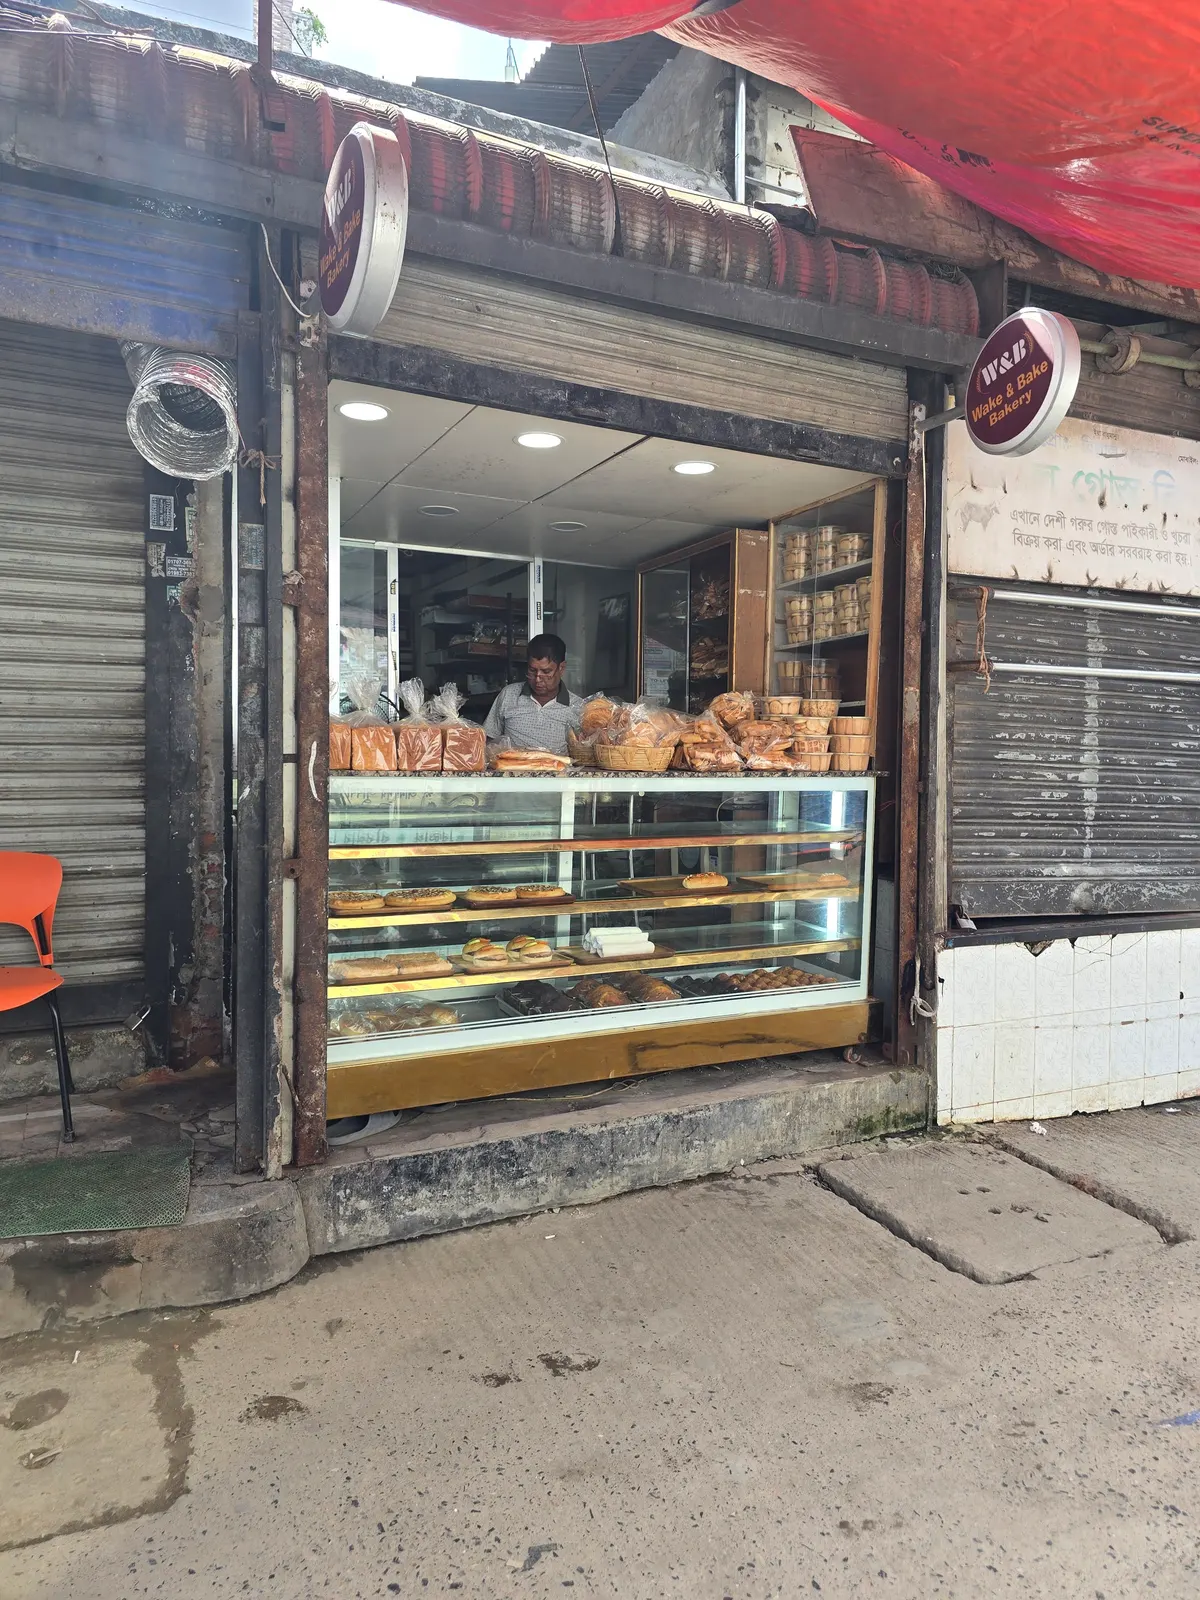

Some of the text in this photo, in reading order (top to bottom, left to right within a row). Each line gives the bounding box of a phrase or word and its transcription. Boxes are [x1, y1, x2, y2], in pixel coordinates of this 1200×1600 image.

[327, 167, 352, 227] W&B
[321, 245, 337, 277] Wake
[343, 209, 361, 245] Bake
[327, 248, 350, 288] Bakery
[981, 338, 1027, 387] W&B
[971, 360, 1049, 423] Wake & Bake
[989, 389, 1033, 427] Bakery
[1010, 509, 1041, 527] এখানে
[1044, 510, 1066, 531] দেশী
[1070, 516, 1094, 532] গরুর
[1162, 529, 1169, 541] ও
[1171, 531, 1192, 547] খুচরা
[1012, 527, 1041, 548] বিক্রয়
[1042, 536, 1063, 552] করা
[1066, 540, 1088, 555] এবং
[1089, 538, 1116, 557] অর্ডার
[1117, 545, 1153, 563] সরবরাহ
[1154, 549, 1173, 564] করা
